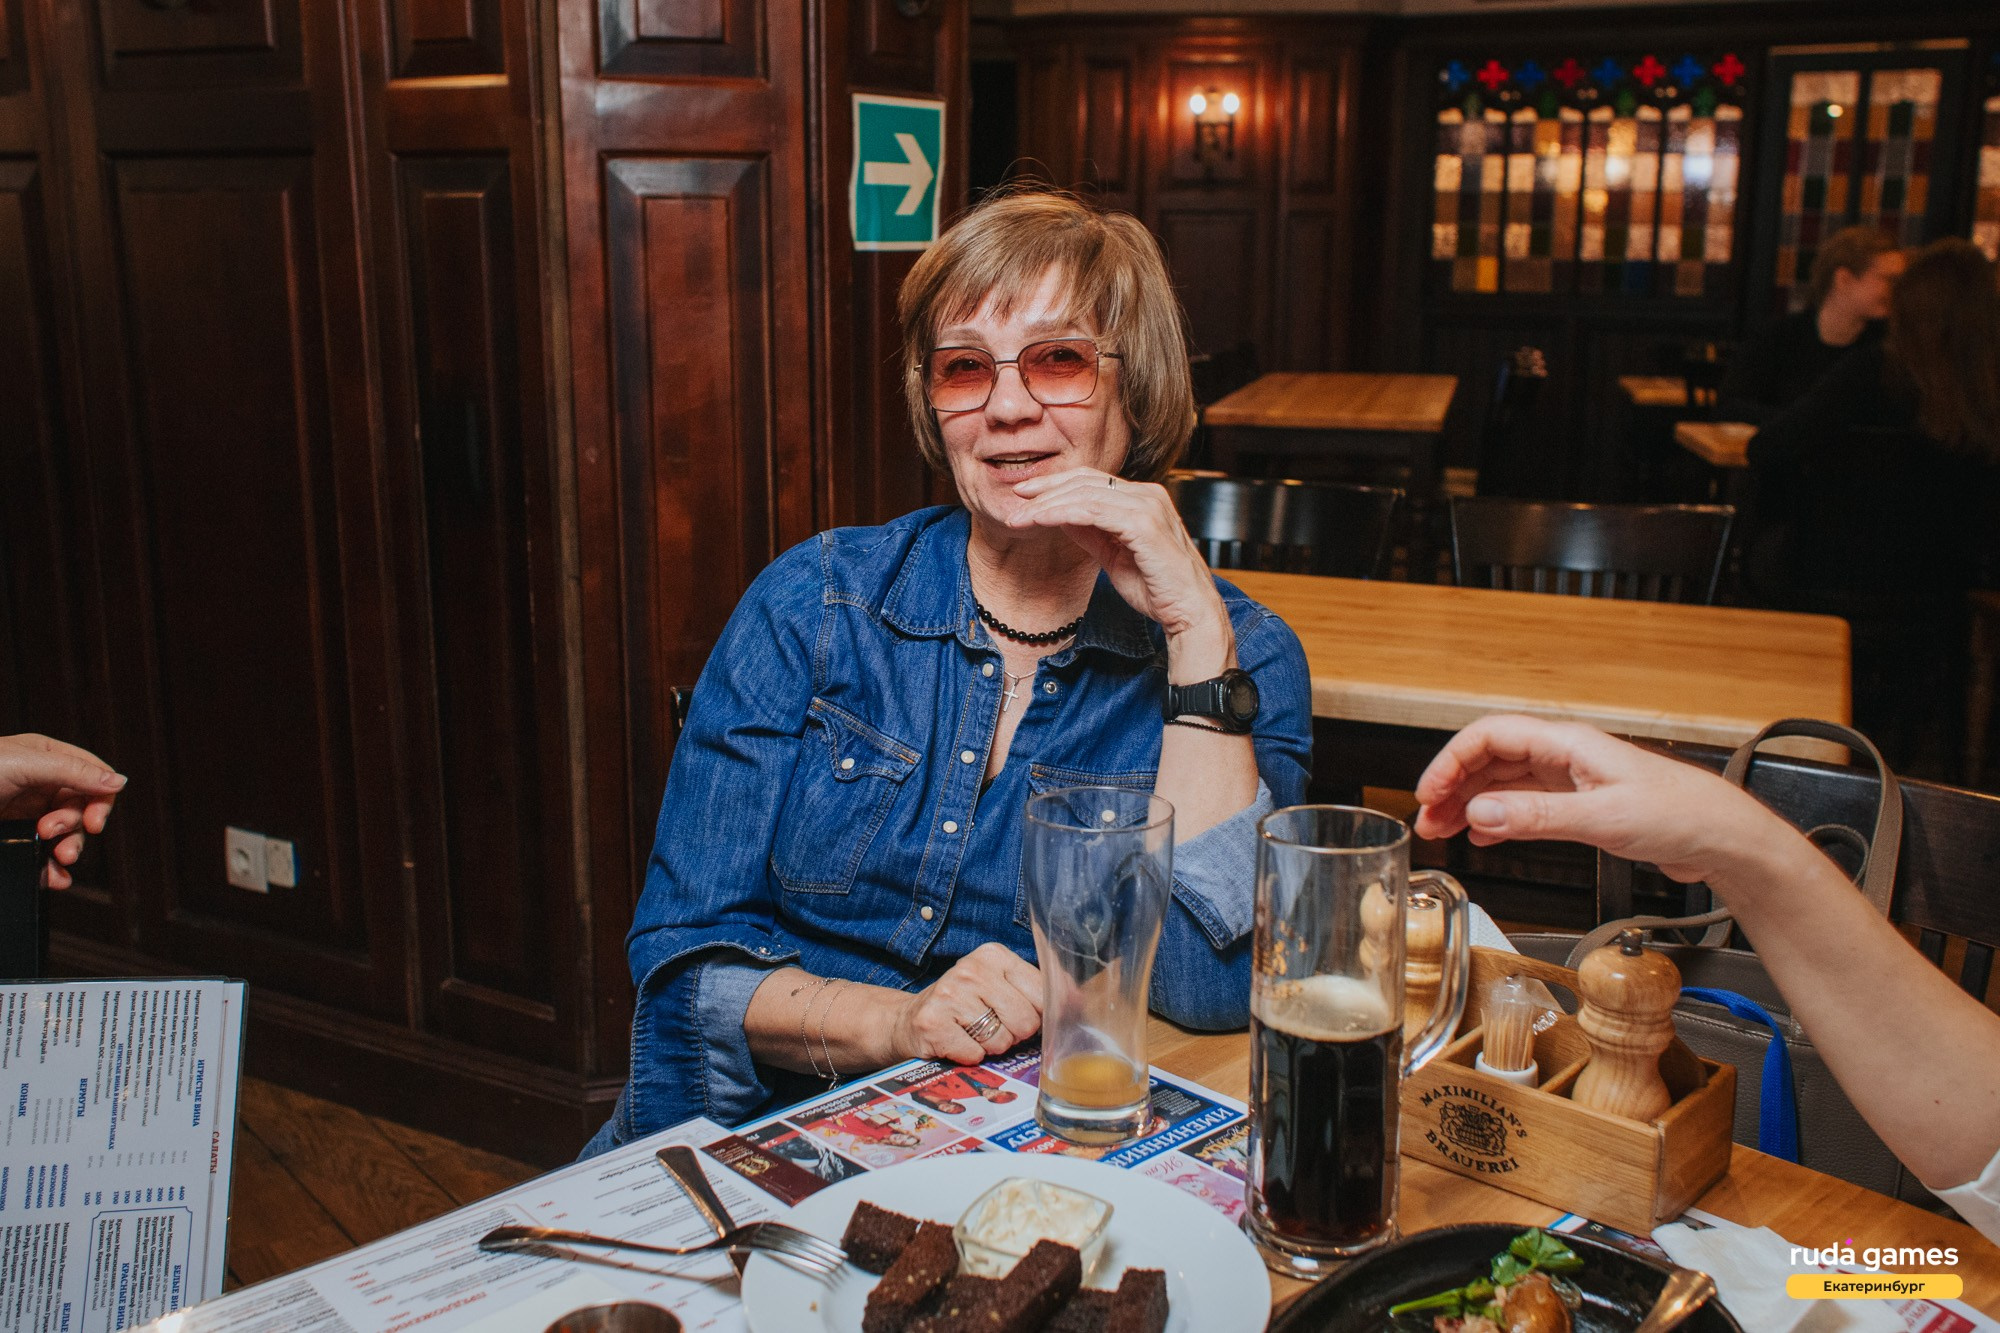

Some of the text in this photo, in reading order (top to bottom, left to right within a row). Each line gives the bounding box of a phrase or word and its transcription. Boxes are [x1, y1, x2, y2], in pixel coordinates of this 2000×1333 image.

[44, 992, 52, 1018] Мартини
[67, 991, 75, 1017] Мартини
[183, 990, 191, 1015] Мартини
[40, 1039, 48, 1054] Драй
[127, 1011, 136, 1048] Полусладкое
[115, 1043, 123, 1074] ИГРИСТЫЕ
[136, 1043, 144, 1064] Тамань
[18, 1083, 28, 1117] КОНЬЯК
[77, 1078, 87, 1117] ВЕРМУТЫ
[192, 1059, 204, 1127] ИГРИСТЫЕ ВИНА
[1419, 1085, 1528, 1139] MAXIMILIAN'S
[108, 1117, 116, 1149] БУТЫЛКАХ
[210, 1131, 219, 1173] САЛАТЫ
[1424, 1128, 1520, 1174] BRAUEREI
[24, 1166, 34, 1209] 460/2300/4600
[36, 1165, 45, 1208] 460/2300/4600
[48, 1164, 57, 1208] 460/2300/4600
[59, 1164, 68, 1207] 460/2300/4600
[116, 1263, 129, 1330] КРАСНЫЕ ВИНА
[170, 1265, 181, 1313] БЕЛЫЕ ВИН
[61, 1302, 71, 1332] БЕЛЫЕ
